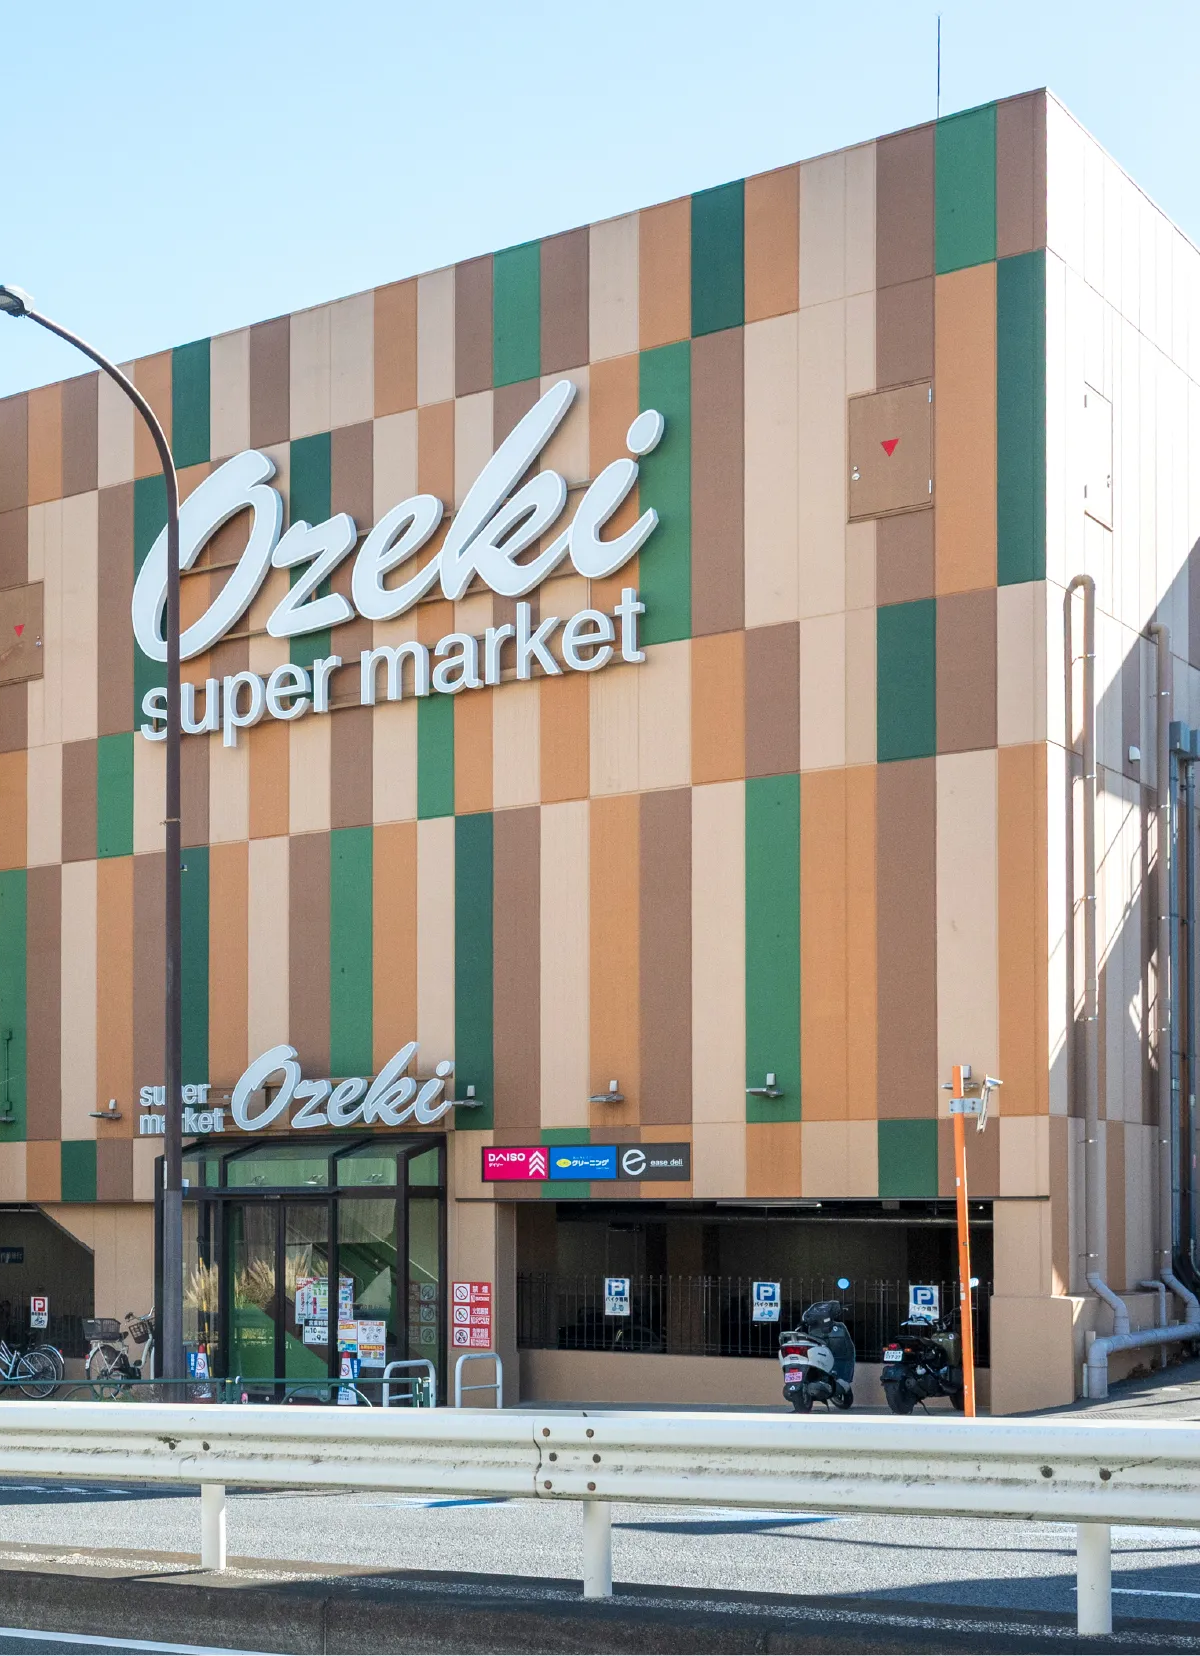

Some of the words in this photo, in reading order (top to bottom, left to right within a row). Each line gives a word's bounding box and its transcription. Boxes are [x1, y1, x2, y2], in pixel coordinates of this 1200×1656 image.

[132, 379, 665, 662] Ozeki
[140, 655, 342, 748] super
[360, 587, 646, 705] market
[231, 1041, 453, 1131] Ozeki
[139, 1083, 212, 1107] suer
[488, 1152, 526, 1162] DAISO
[572, 1158, 610, 1167] クリーニング
[670, 1158, 684, 1166] deli
[611, 1281, 624, 1294] P
[760, 1286, 772, 1299] P
[917, 1290, 931, 1304] P
